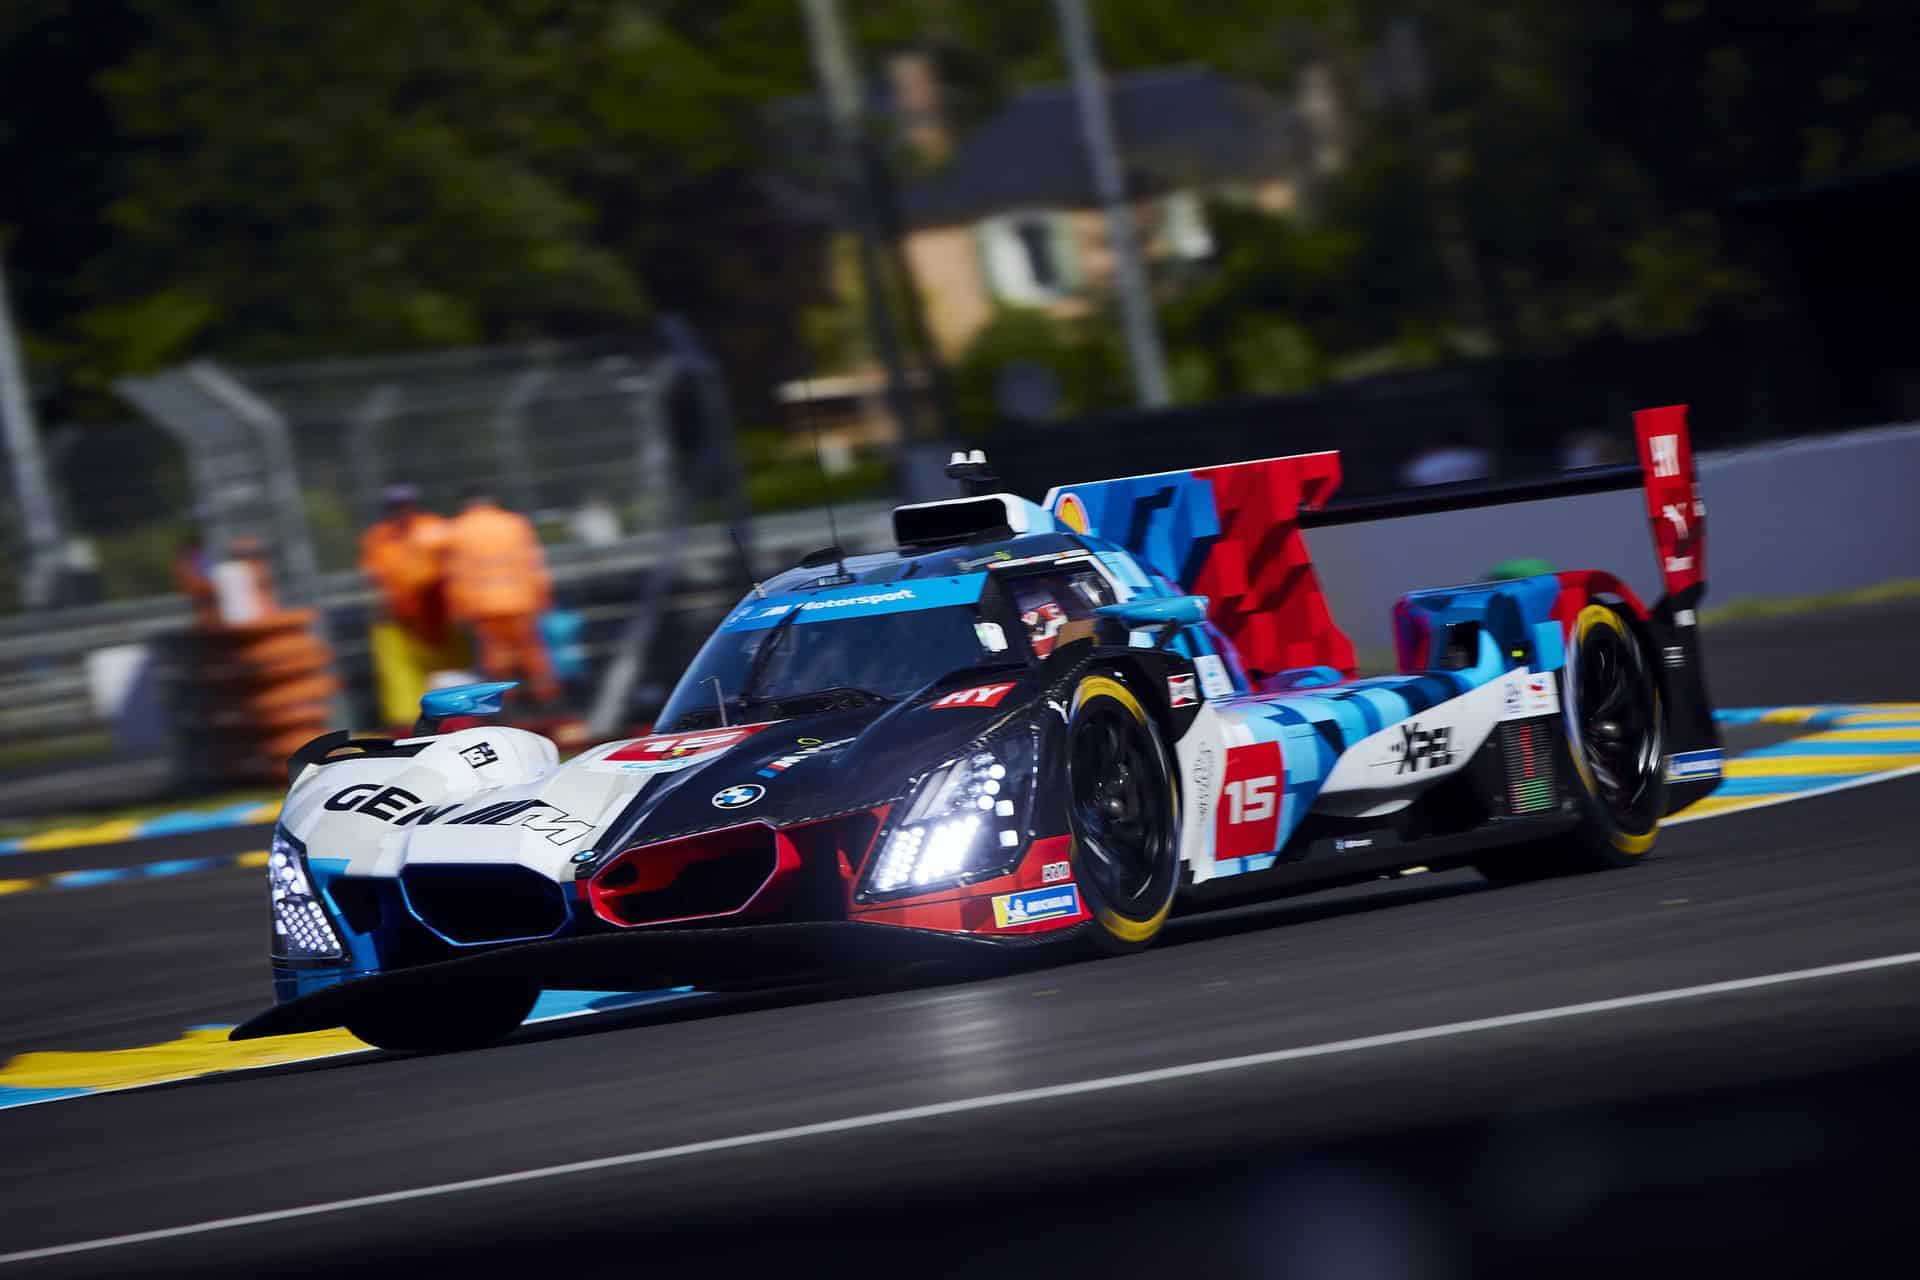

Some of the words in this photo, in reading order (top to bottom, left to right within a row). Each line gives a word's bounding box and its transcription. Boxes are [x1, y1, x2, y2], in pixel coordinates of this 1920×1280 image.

[936, 686, 1009, 706] HY
[324, 783, 464, 826] GEN
[1223, 775, 1277, 825] 15
